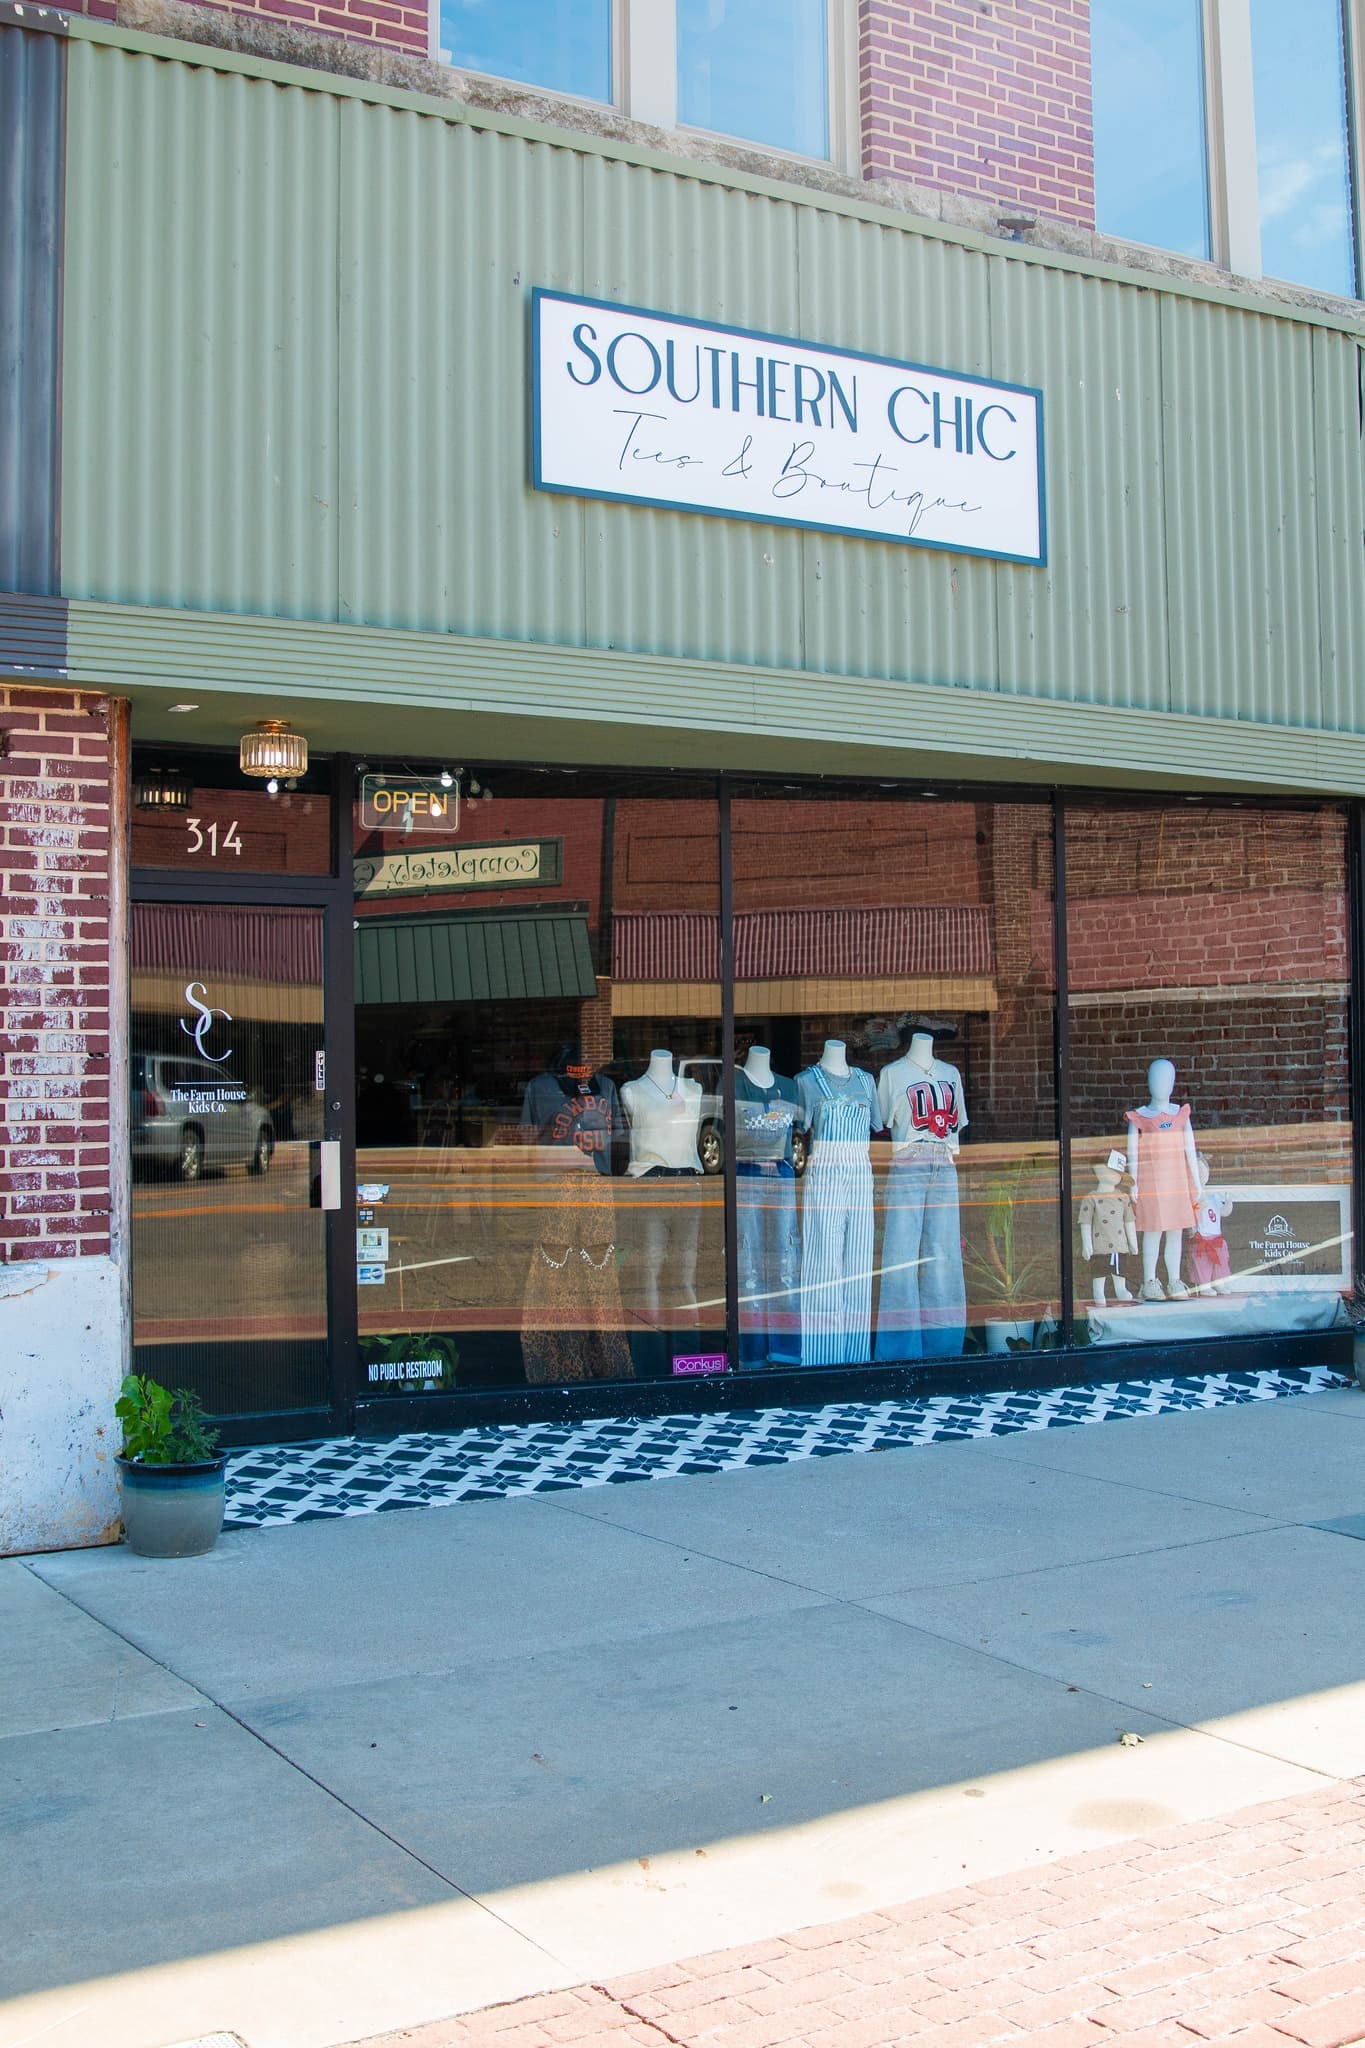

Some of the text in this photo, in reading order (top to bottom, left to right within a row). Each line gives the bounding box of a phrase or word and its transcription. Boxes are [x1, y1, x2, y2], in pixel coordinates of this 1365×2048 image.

[566, 323, 1017, 461] SOUTHERN CHIC
[613, 409, 982, 536] Tees & Boutique
[373, 790, 448, 815] OPEN
[186, 818, 243, 857] 314
[170, 1088, 246, 1102] The Farm House
[188, 1101, 227, 1114] Kids Co.
[1249, 1240, 1310, 1249] The Farm House
[1264, 1249, 1282, 1258] Kids
[368, 1359, 443, 1382] NO PUBLIC RESTROOM
[677, 1358, 722, 1372] Corkys
